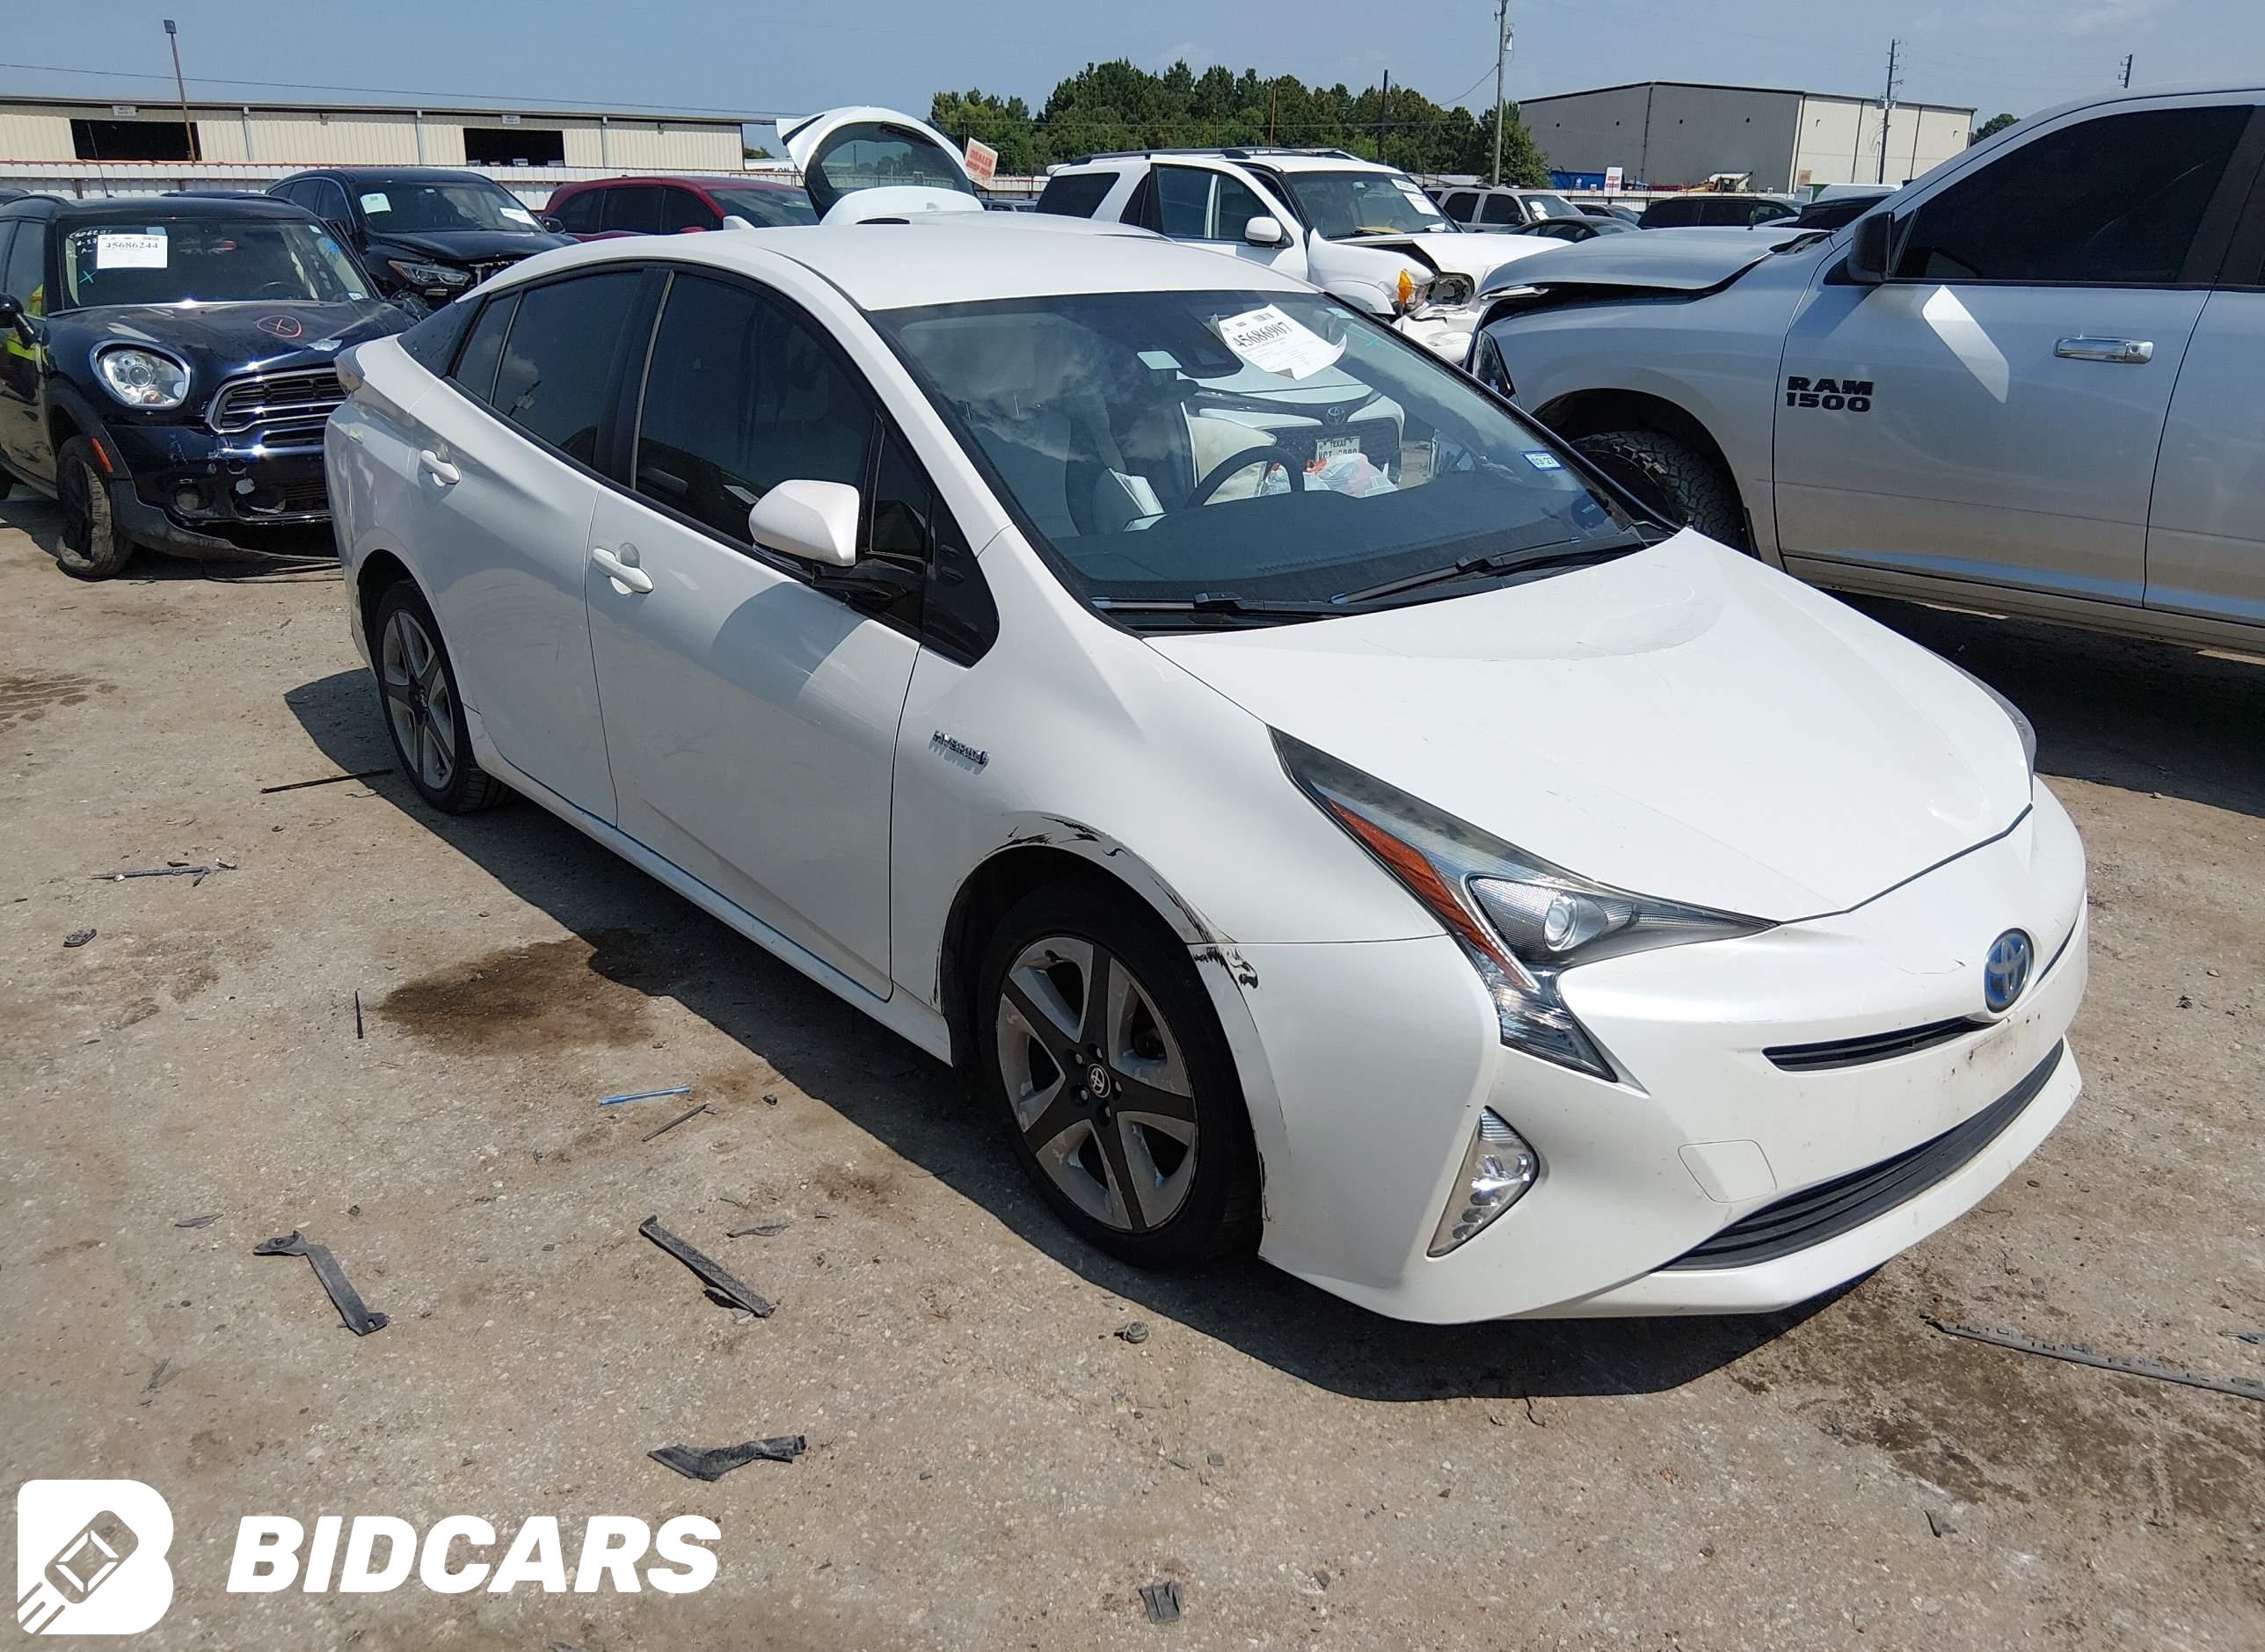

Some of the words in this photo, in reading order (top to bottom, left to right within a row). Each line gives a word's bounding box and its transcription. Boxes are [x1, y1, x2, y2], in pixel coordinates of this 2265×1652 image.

[1233, 321, 1293, 348] 45686907
[1787, 375, 1874, 396] RAM
[1786, 392, 1870, 412] 1500
